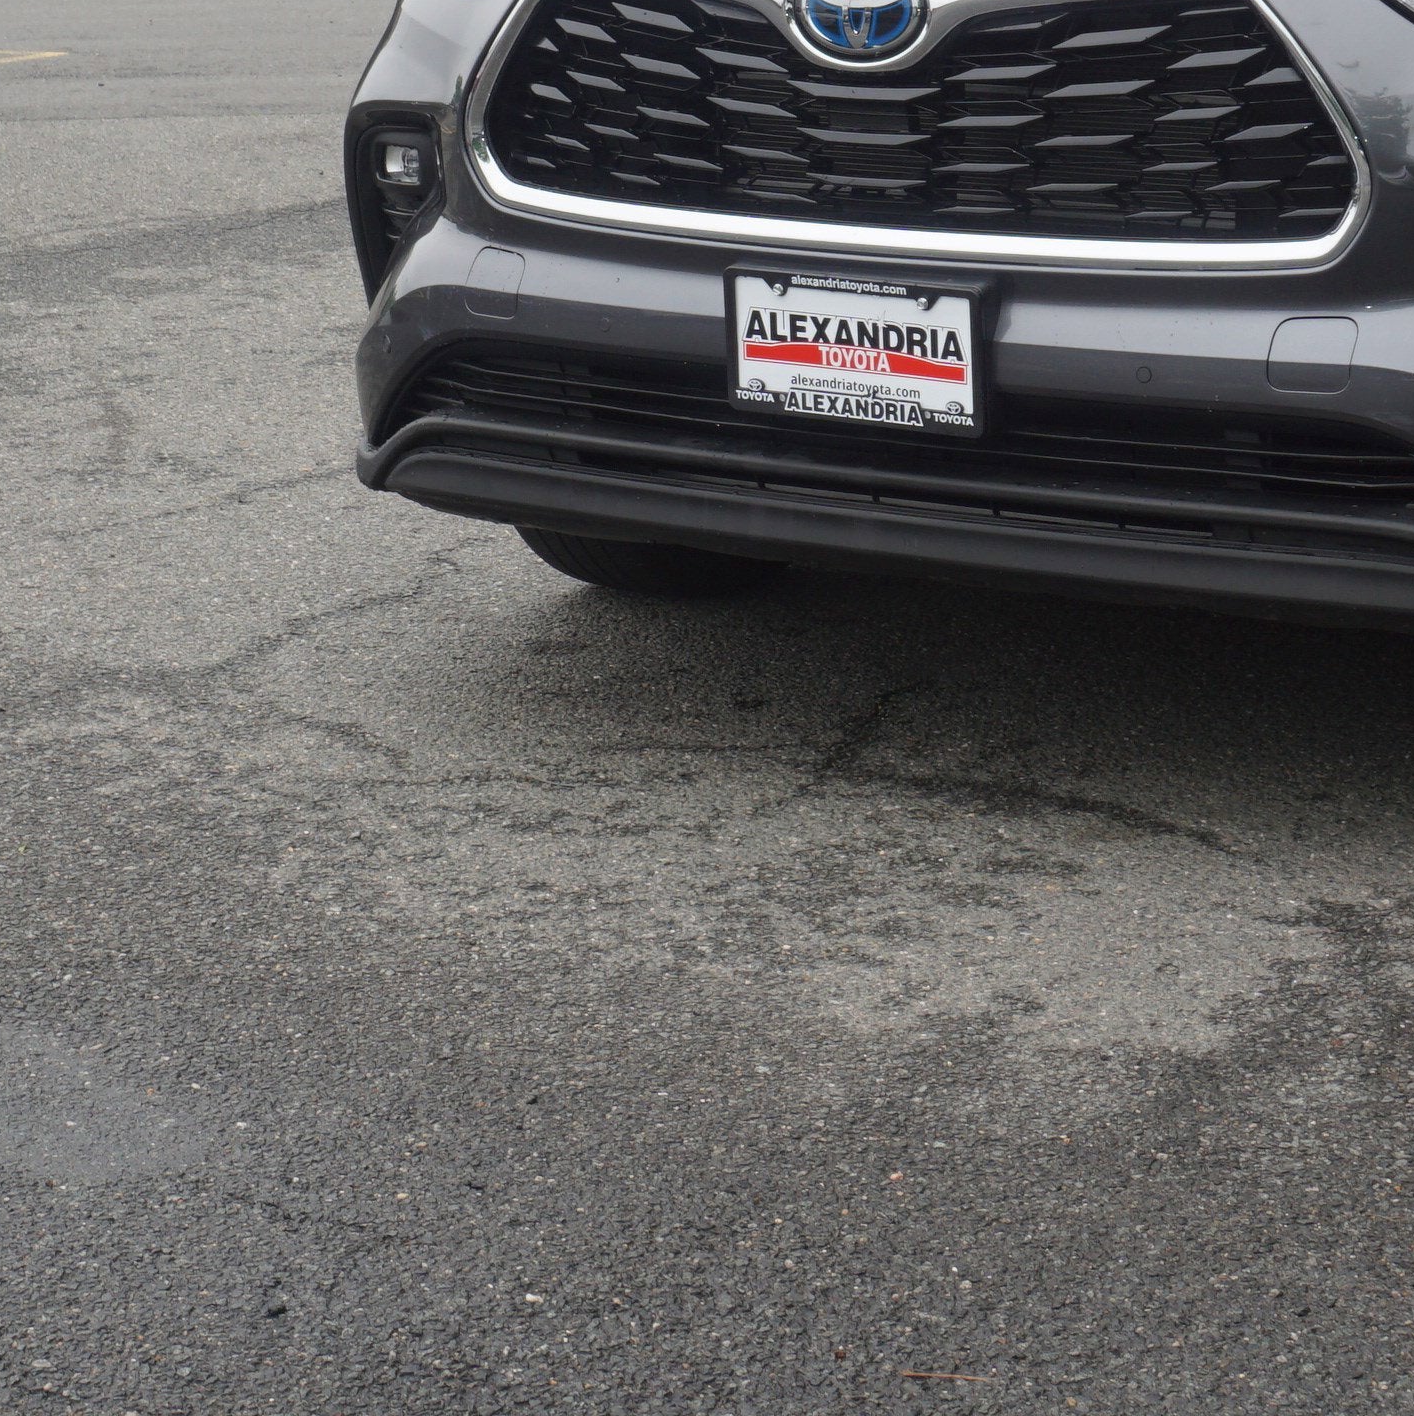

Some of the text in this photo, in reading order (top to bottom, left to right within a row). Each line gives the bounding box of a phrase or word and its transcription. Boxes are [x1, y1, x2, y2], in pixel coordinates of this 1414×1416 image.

[790, 274, 907, 296] alexandriatoyota.com
[745, 309, 965, 362] ALEXANDRIA
[818, 345, 891, 372] TOYOTA
[790, 373, 921, 400] alexandriatoyota.com
[735, 389, 974, 427] TOYOTA ALEXANDRIA TOYOTA
